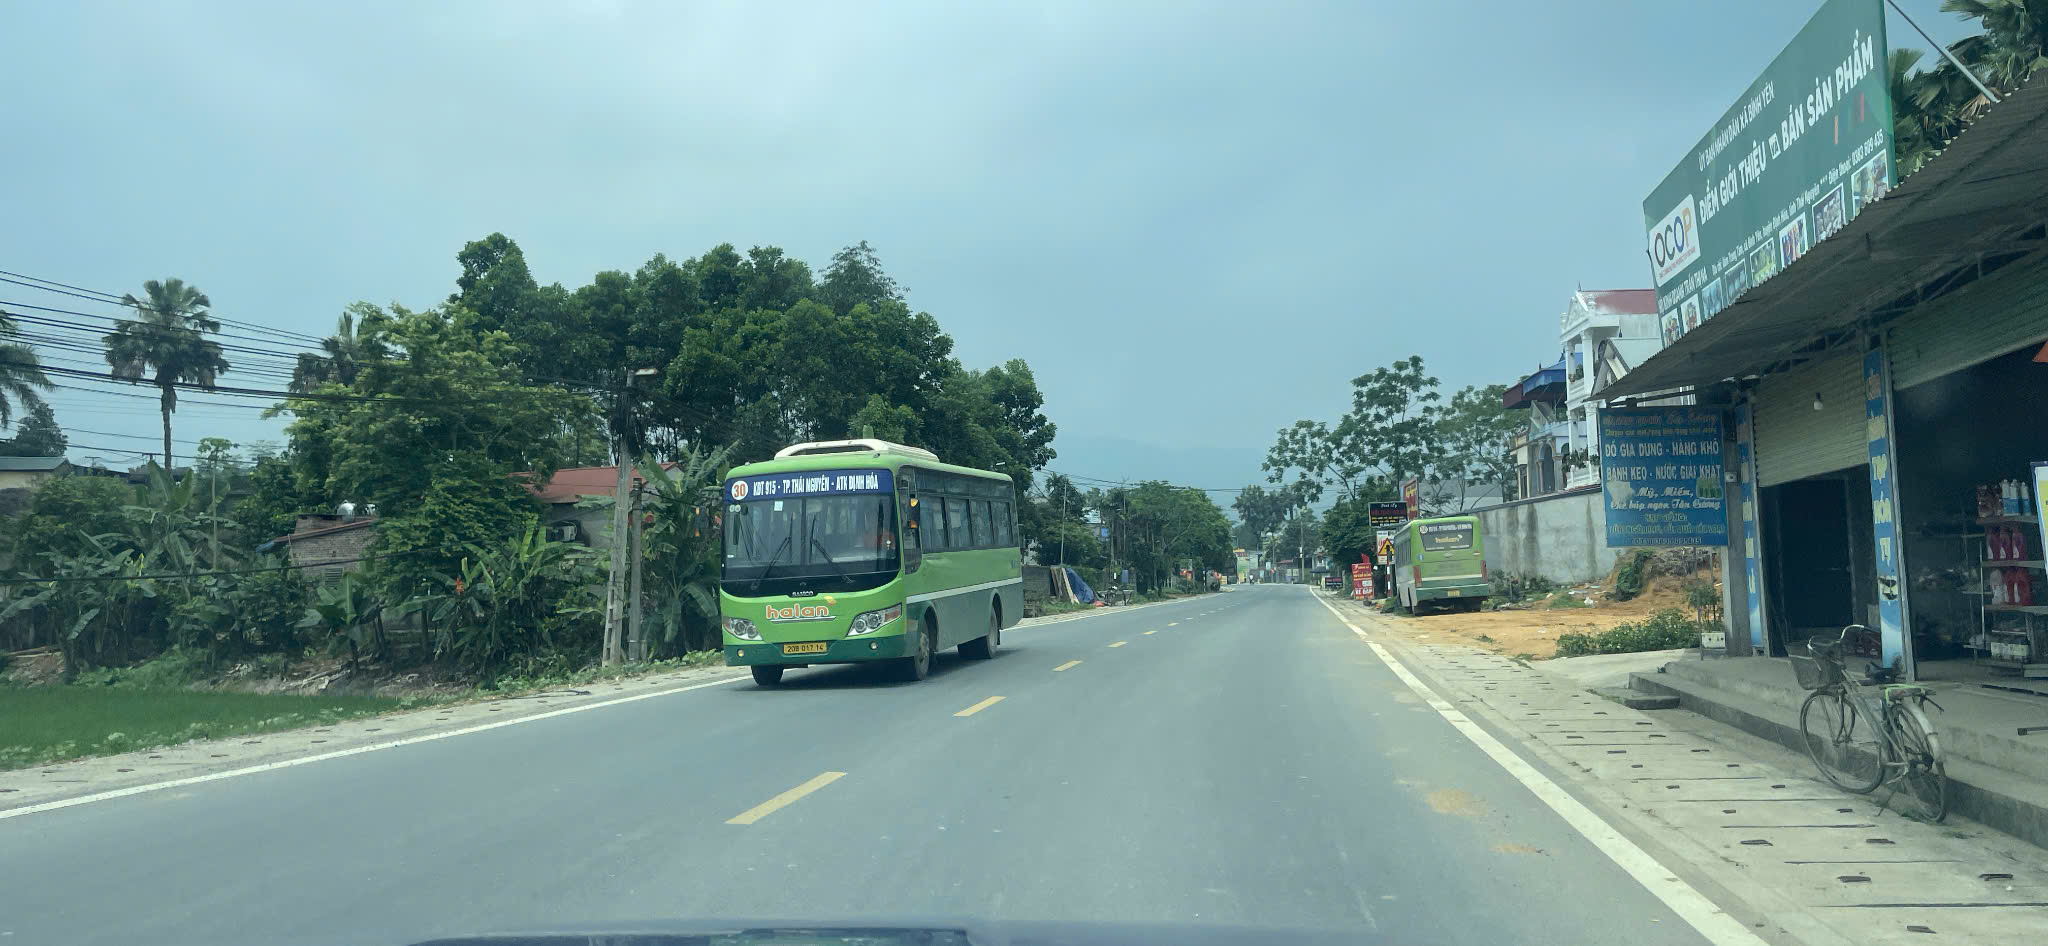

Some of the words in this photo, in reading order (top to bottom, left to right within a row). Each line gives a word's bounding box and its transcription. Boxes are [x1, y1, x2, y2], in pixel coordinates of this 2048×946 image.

[1762, 81, 1774, 108] YÊN
[1700, 179, 1719, 225] ĐIỂM
[1720, 164, 1738, 206] GIỚI
[1739, 140, 1766, 189] THIỆU
[1782, 104, 1804, 151] BÁN
[1807, 77, 1833, 127] SẢN
[1836, 29, 1874, 101] PHẨM
[1655, 208, 1691, 267] OCOP
[1620, 442, 1636, 457] GIA
[1700, 438, 1719, 455] KHÔ
[734, 483, 746, 498] 30
[766, 480, 777, 495] 915
[783, 480, 791, 494] TP.
[792, 476, 805, 494] THÁI
[806, 474, 830, 493] NGUYÊN
[836, 475, 848, 491] ATK
[865, 472, 879, 490] HÓA
[766, 603, 829, 620] halan
[788, 645, 800, 653] 20B
